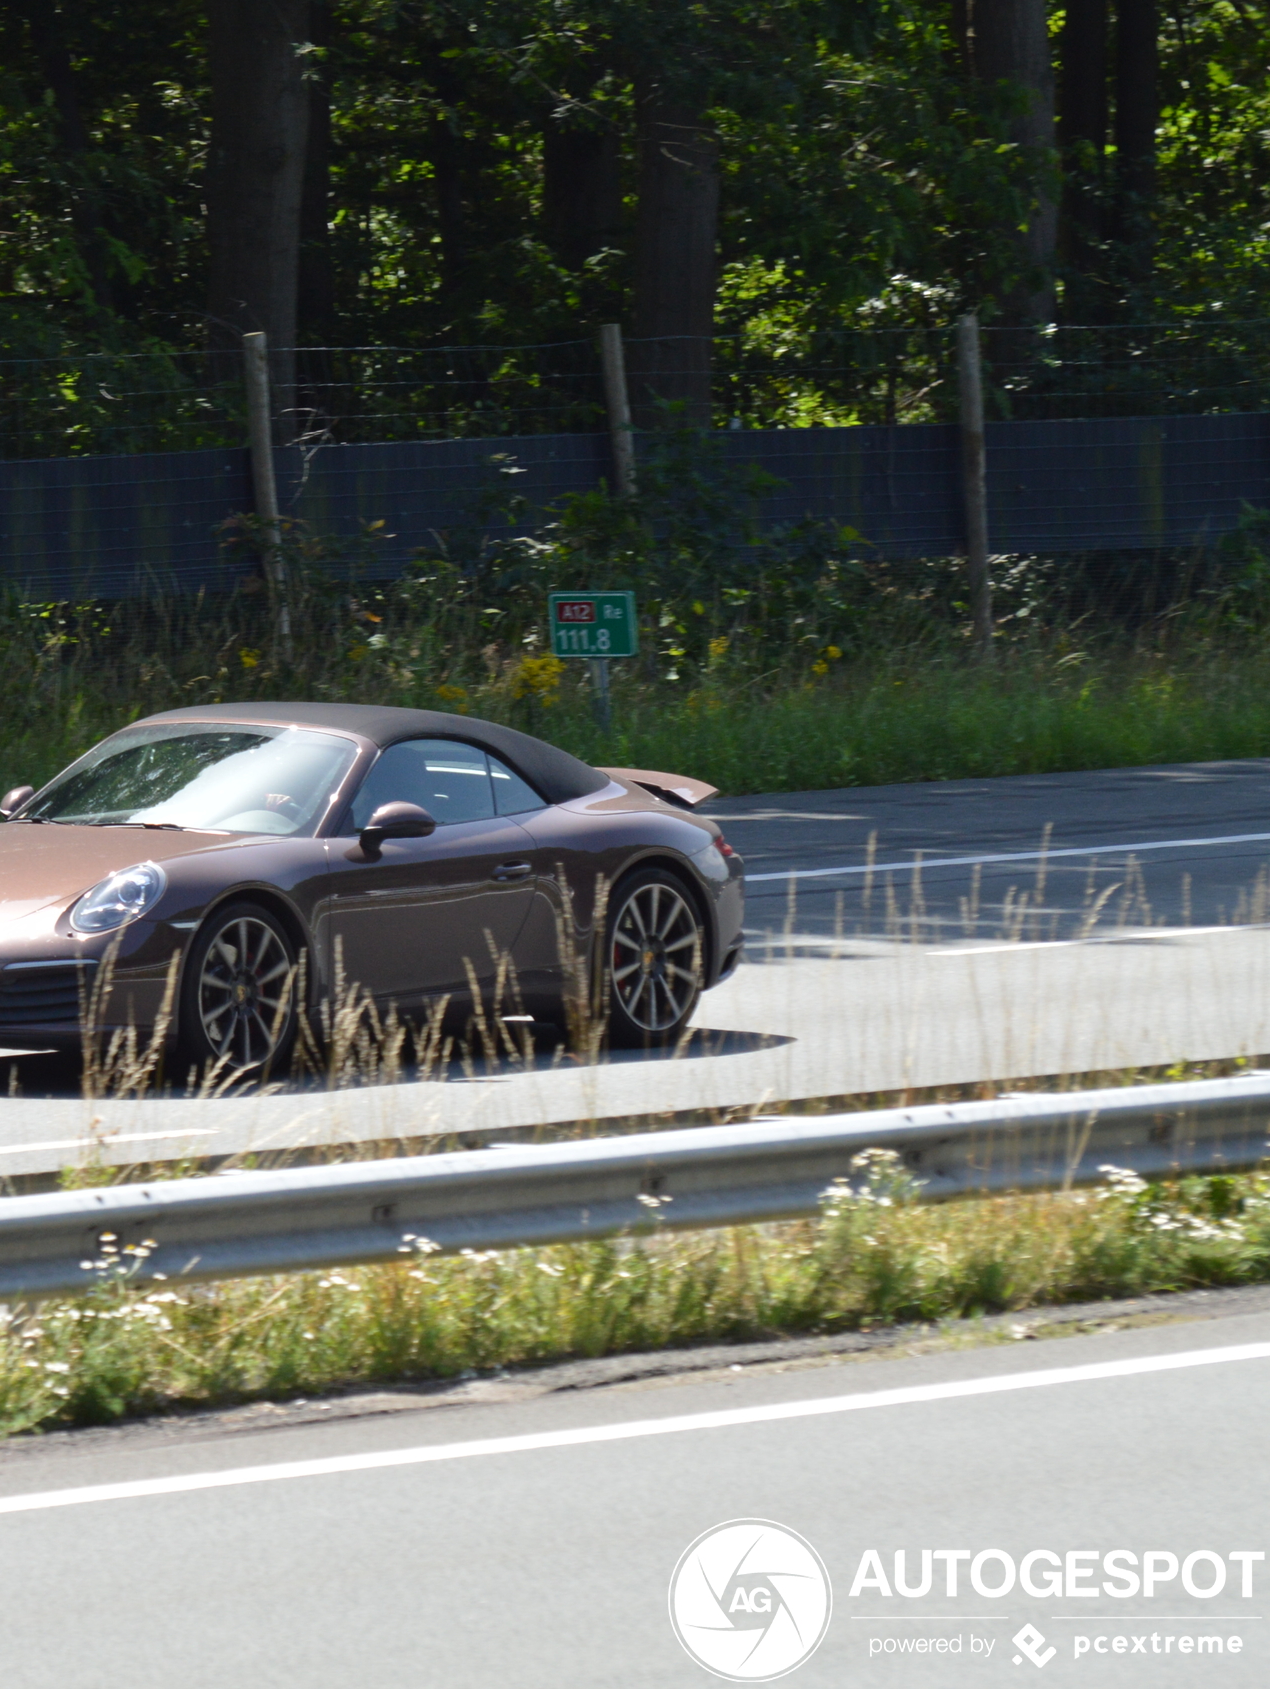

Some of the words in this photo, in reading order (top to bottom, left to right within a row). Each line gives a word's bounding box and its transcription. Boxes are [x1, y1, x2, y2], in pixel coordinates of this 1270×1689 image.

[562, 604, 591, 620] A12
[603, 604, 624, 619] Re
[557, 628, 611, 651] 111.8
